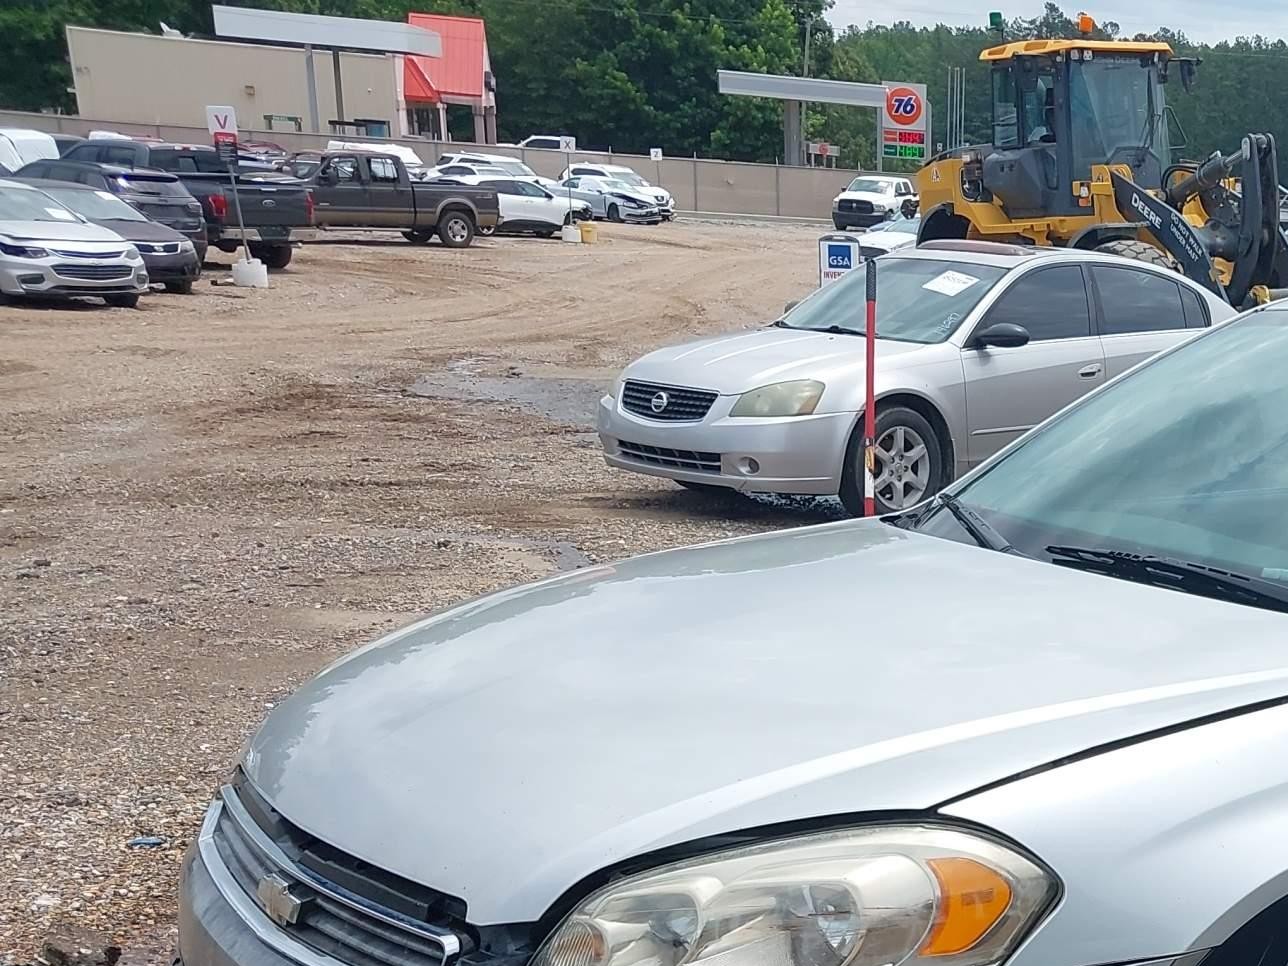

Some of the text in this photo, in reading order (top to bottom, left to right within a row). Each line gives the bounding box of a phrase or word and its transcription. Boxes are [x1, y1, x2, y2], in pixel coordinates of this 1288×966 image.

[892, 95, 916, 116] 76
[214, 115, 227, 129] V
[564, 140, 572, 150] X
[1131, 192, 1162, 229] DEERE
[829, 256, 851, 266] GSA
